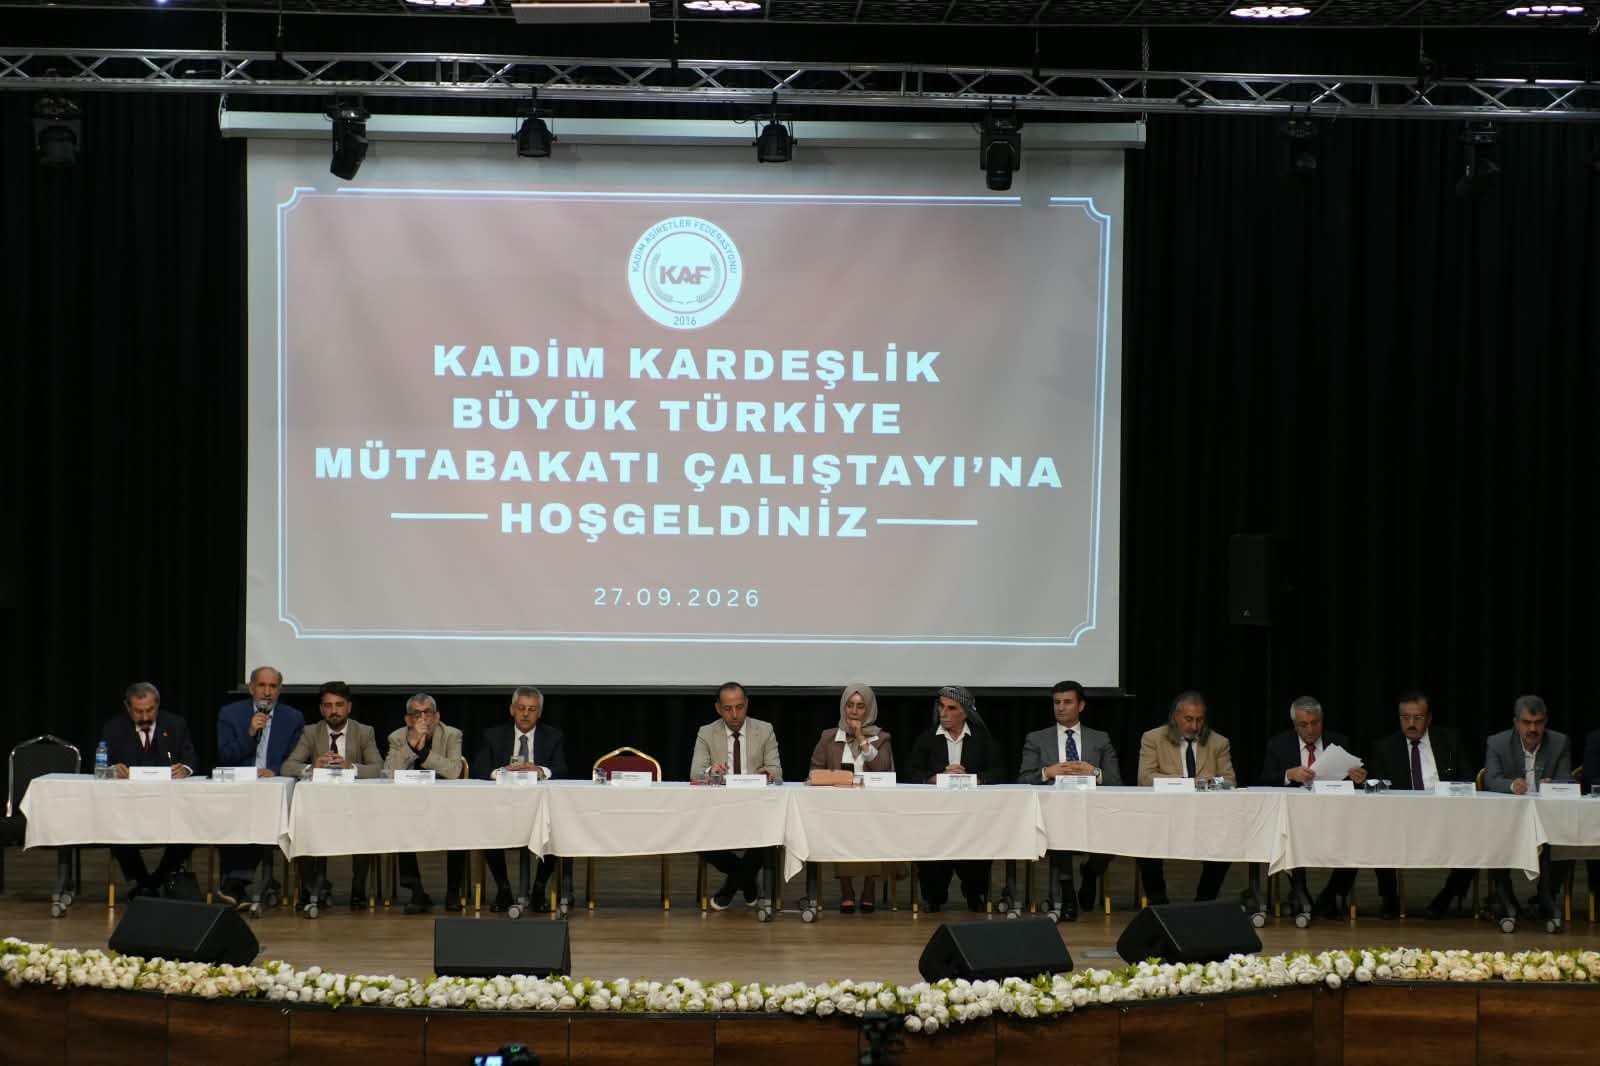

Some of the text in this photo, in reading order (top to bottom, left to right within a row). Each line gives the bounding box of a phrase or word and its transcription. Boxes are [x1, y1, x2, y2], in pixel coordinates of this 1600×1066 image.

[694, 220, 737, 273] FEDERASYONU
[660, 265, 711, 285] KAF
[674, 315, 697, 326] 2016
[434, 338, 940, 389] KADİM KARDEŞLİK
[453, 389, 901, 434] BÜYÜK TÜRKİYE
[315, 440, 659, 482] MÜTABAKATI
[501, 497, 867, 543] HOŞGELDİNİZ
[594, 587, 759, 608] 27.09.2026
